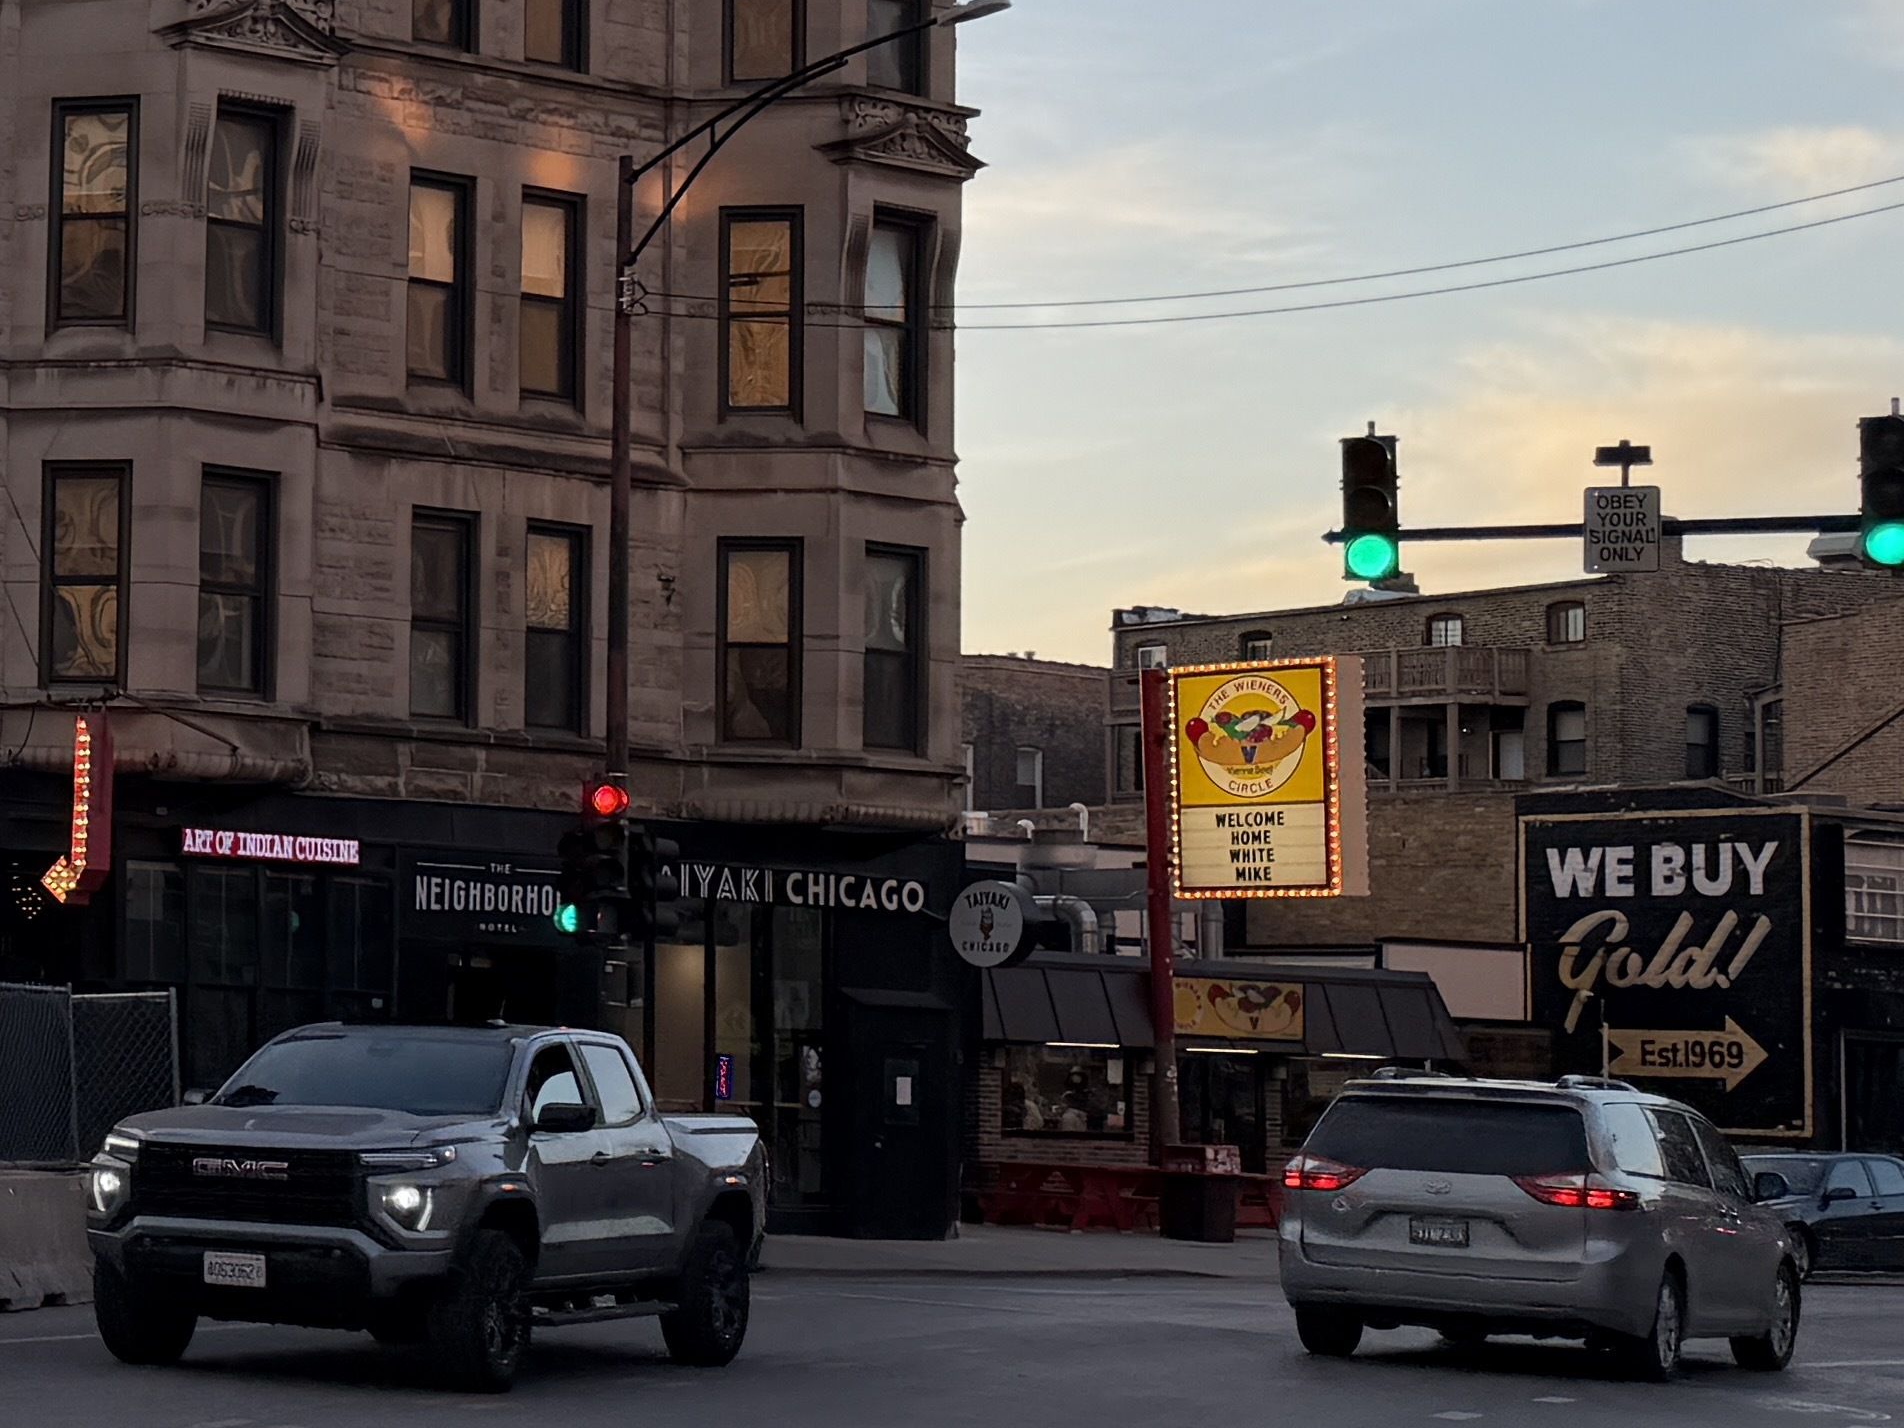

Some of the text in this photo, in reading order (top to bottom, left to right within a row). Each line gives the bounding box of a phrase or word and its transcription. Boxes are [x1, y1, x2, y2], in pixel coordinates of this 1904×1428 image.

[1596, 493, 1647, 510] OBEY
[1596, 511, 1647, 528] YOUR
[1589, 528, 1656, 545] SIGNAL
[1599, 545, 1645, 562] ONLY
[1207, 679, 1289, 711] THE WIENERS
[1228, 777, 1274, 795] CIRCLE
[1215, 811, 1285, 829] WELCOME
[182, 827, 361, 865] ART OF INDIAN CUISINE
[1231, 829, 1272, 846] HOME
[1229, 847, 1275, 864] WHITE
[489, 862, 513, 875] THE
[1235, 865, 1272, 882] MIKE
[1544, 840, 1780, 899] WE BUY
[415, 874, 562, 917] NEIGHBORHO
[785, 871, 925, 914] CHICAGO
[964, 889, 1011, 911] TAIYAKI
[961, 940, 1010, 954] CHICAGO
[1557, 908, 1773, 1035] Gold!
[192, 1157, 289, 1181] GMC
